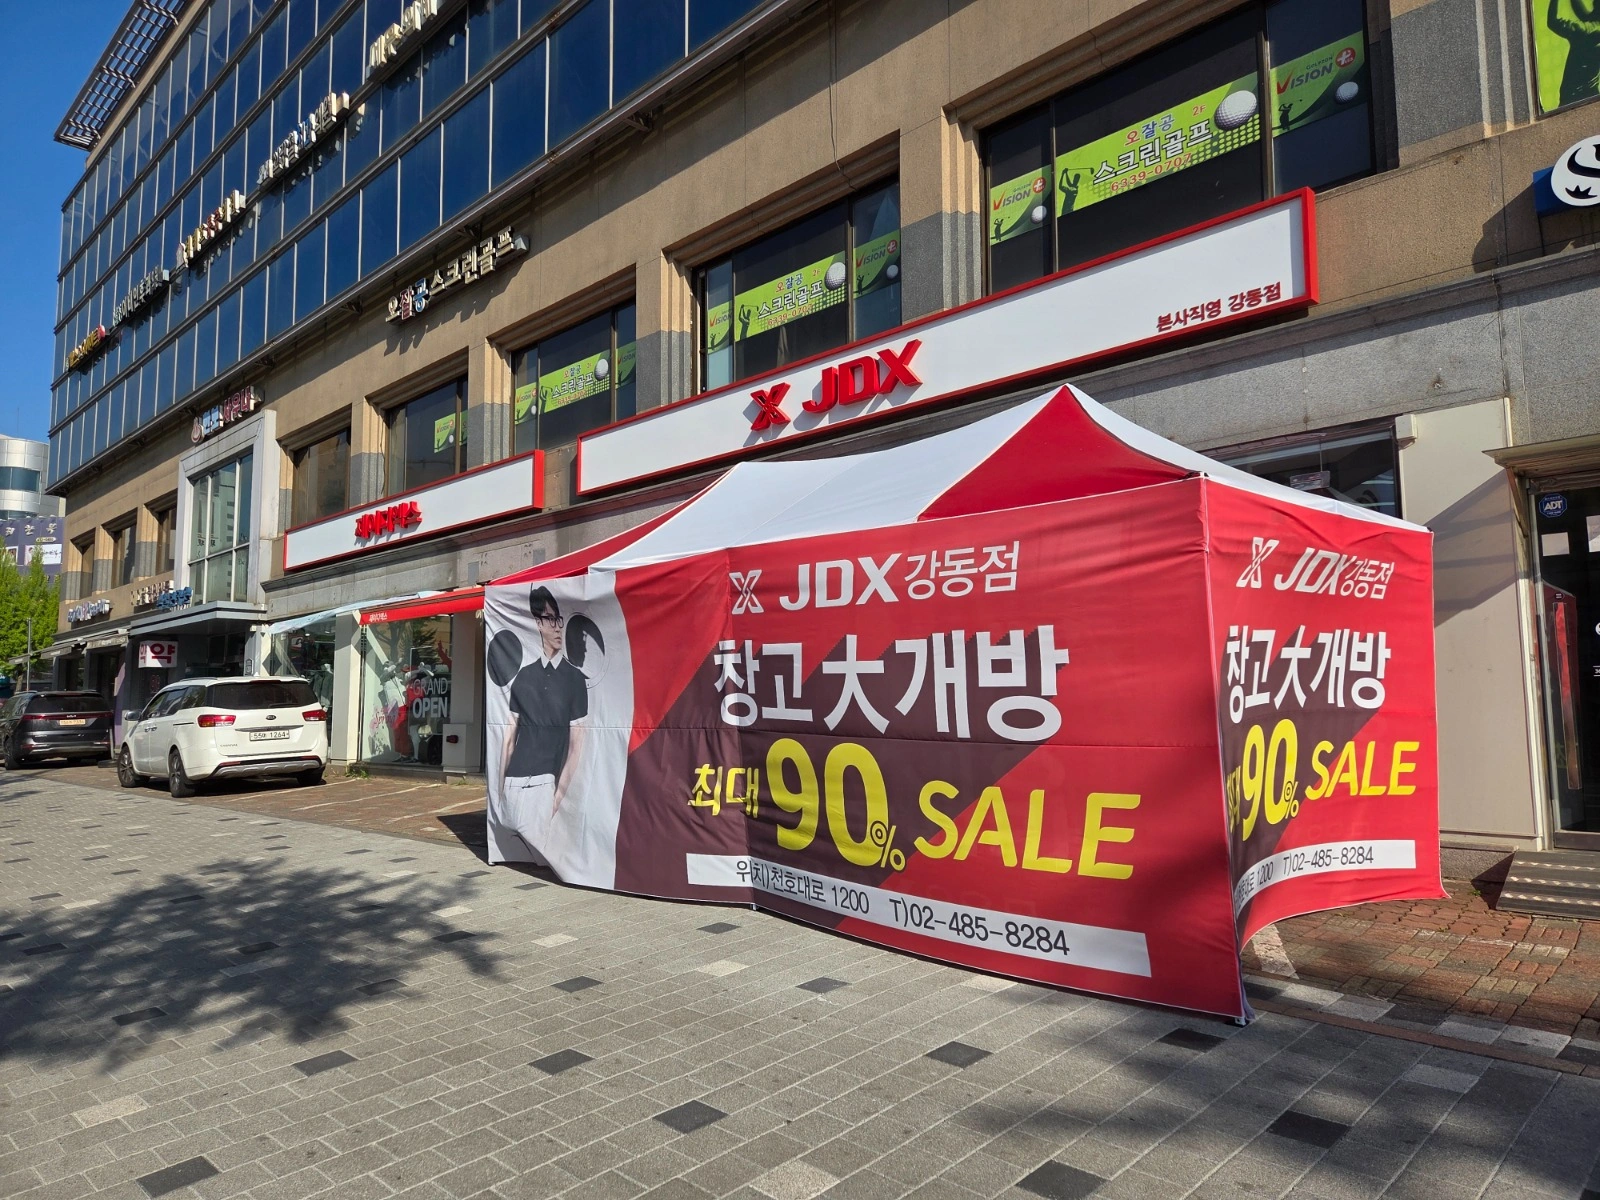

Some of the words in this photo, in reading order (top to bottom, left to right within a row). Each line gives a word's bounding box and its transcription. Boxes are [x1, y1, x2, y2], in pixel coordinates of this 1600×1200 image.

[1276, 63, 1334, 95] VISION
[1125, 114, 1175, 146] 오잘공
[1192, 104, 1207, 117] 2F
[1093, 119, 1213, 185] 스크린골프
[1111, 152, 1192, 192] 6339-0707
[993, 190, 1031, 211] VISION
[855, 249, 886, 268] VISION
[758, 280, 823, 319] 스크린골프
[775, 272, 804, 293] 오잘공
[1156, 298, 1222, 333] 본사직영
[1228, 281, 1281, 313] 강동점
[552, 372, 594, 399] 스크린골프
[802, 338, 923, 414] JDX
[355, 501, 422, 539] 제이디엑스
[1543, 500, 1563, 511] ADT
[150, 643, 176, 664] 약
[413, 678, 448, 696] GRAND
[713, 624, 1070, 742] 창고大개방
[1226, 624, 1392, 724] 창고大개방
[412, 697, 448, 719] OPEN
[1304, 740, 1420, 801] SALE
[688, 763, 760, 819] 최대
[913, 779, 1141, 881] SALE
[1256, 861, 1274, 887] 1200
[1283, 846, 1375, 876] T)02-485-8284
[831, 884, 870, 916] 1200
[889, 897, 1071, 957] T)02-485-8284
